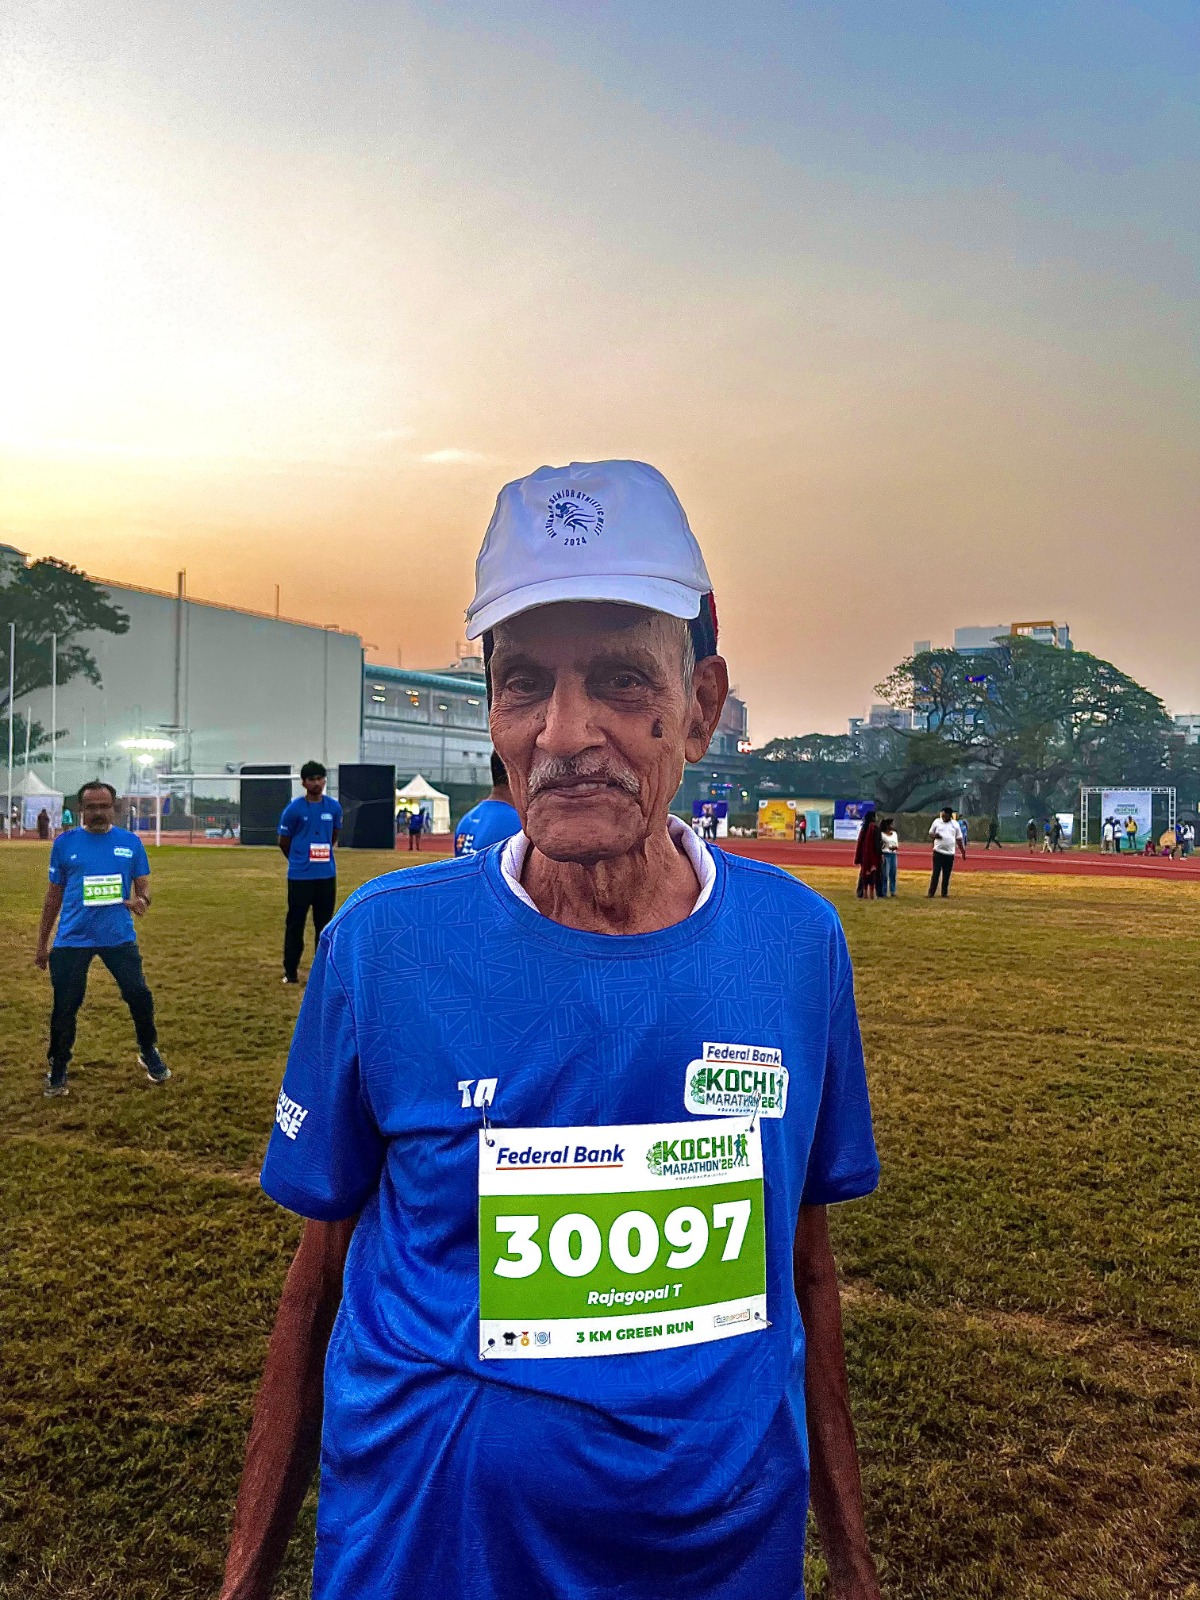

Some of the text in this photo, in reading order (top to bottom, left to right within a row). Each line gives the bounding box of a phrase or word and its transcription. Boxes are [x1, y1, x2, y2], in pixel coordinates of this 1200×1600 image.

[548, 489, 575, 505] SENIOR
[576, 491, 604, 516] ATHLETIC
[594, 517, 604, 536] MEET
[564, 536, 587, 546] 2024
[707, 1046, 780, 1064] Federal Bank
[707, 1067, 776, 1094] KOCHI
[497, 1144, 626, 1164] Federal Bank
[663, 1135, 733, 1162] KOCHI
[493, 1199, 751, 1279] 30097
[587, 1284, 683, 1307] Rajagopal T
[576, 1320, 694, 1343] 3 KM GREEN RUN
